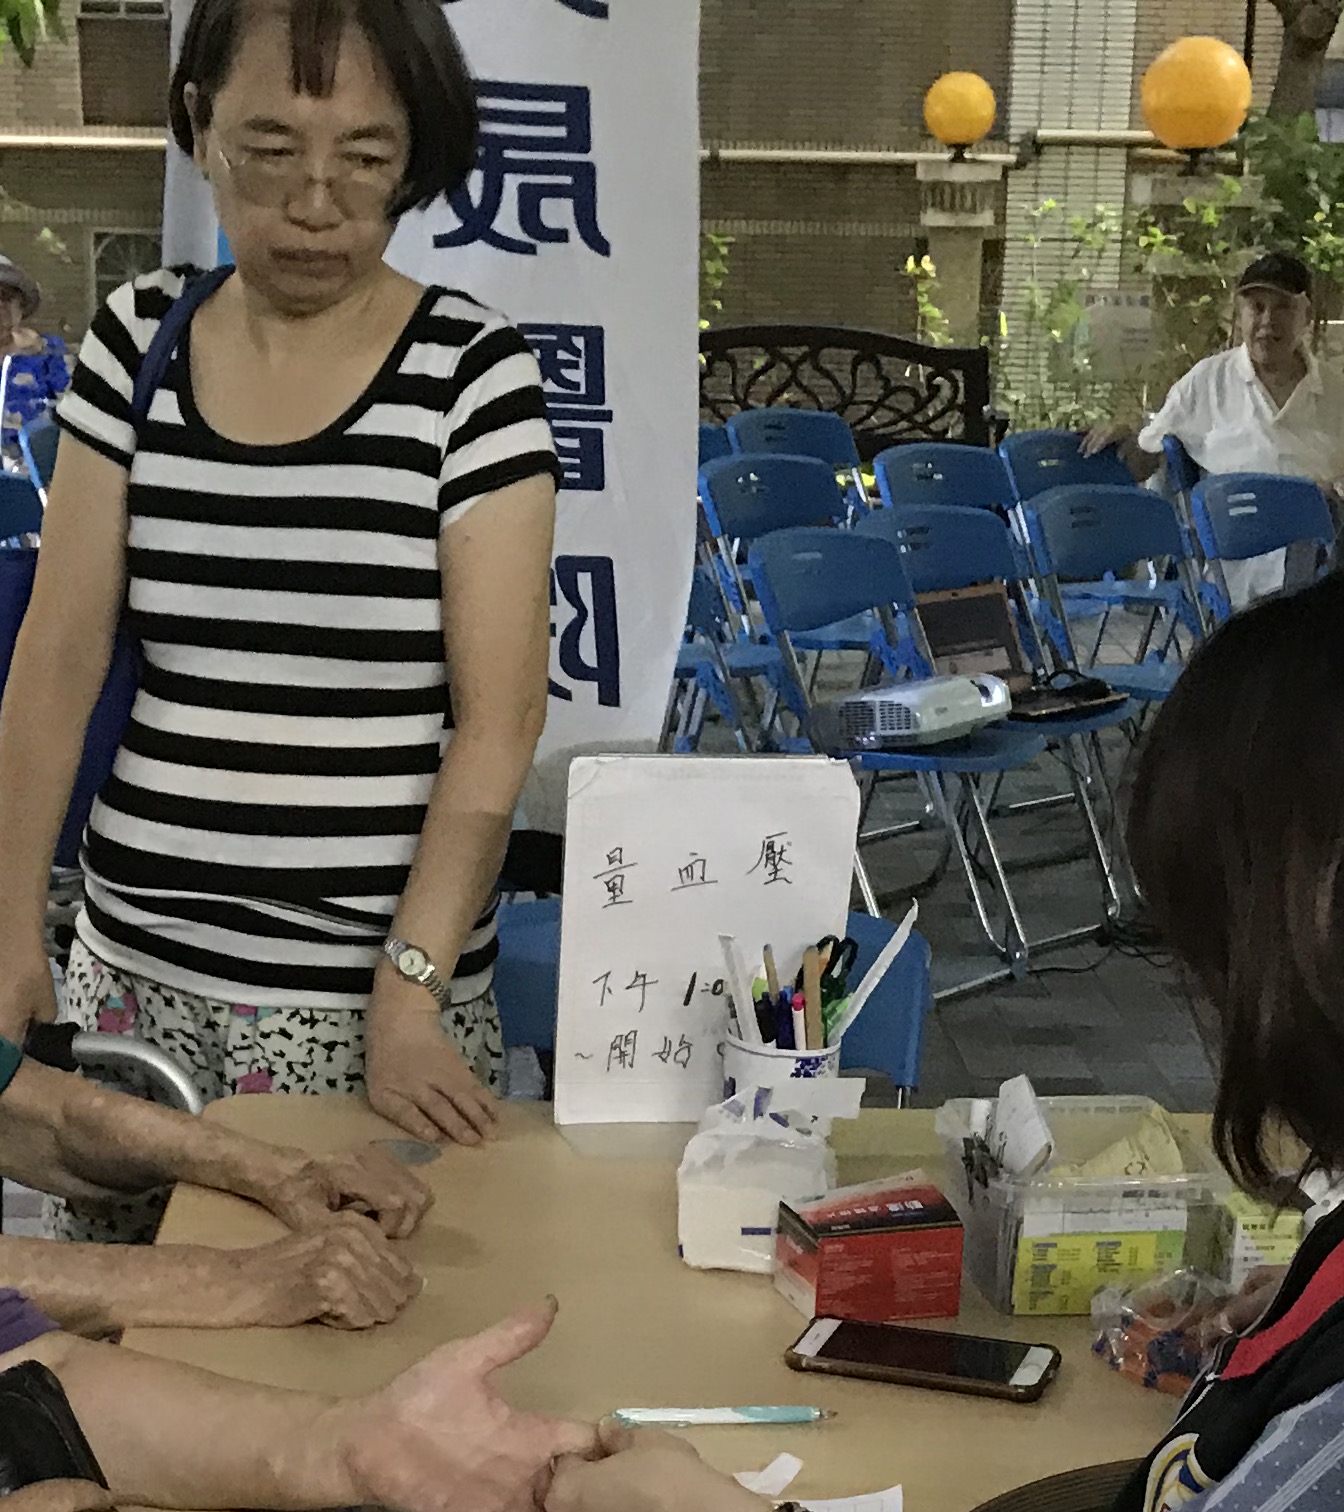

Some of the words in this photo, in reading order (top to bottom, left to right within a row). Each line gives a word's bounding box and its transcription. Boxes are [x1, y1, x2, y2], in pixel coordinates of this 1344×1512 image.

[592, 831, 794, 909] 量血壓
[592, 969, 659, 1013] 下午
